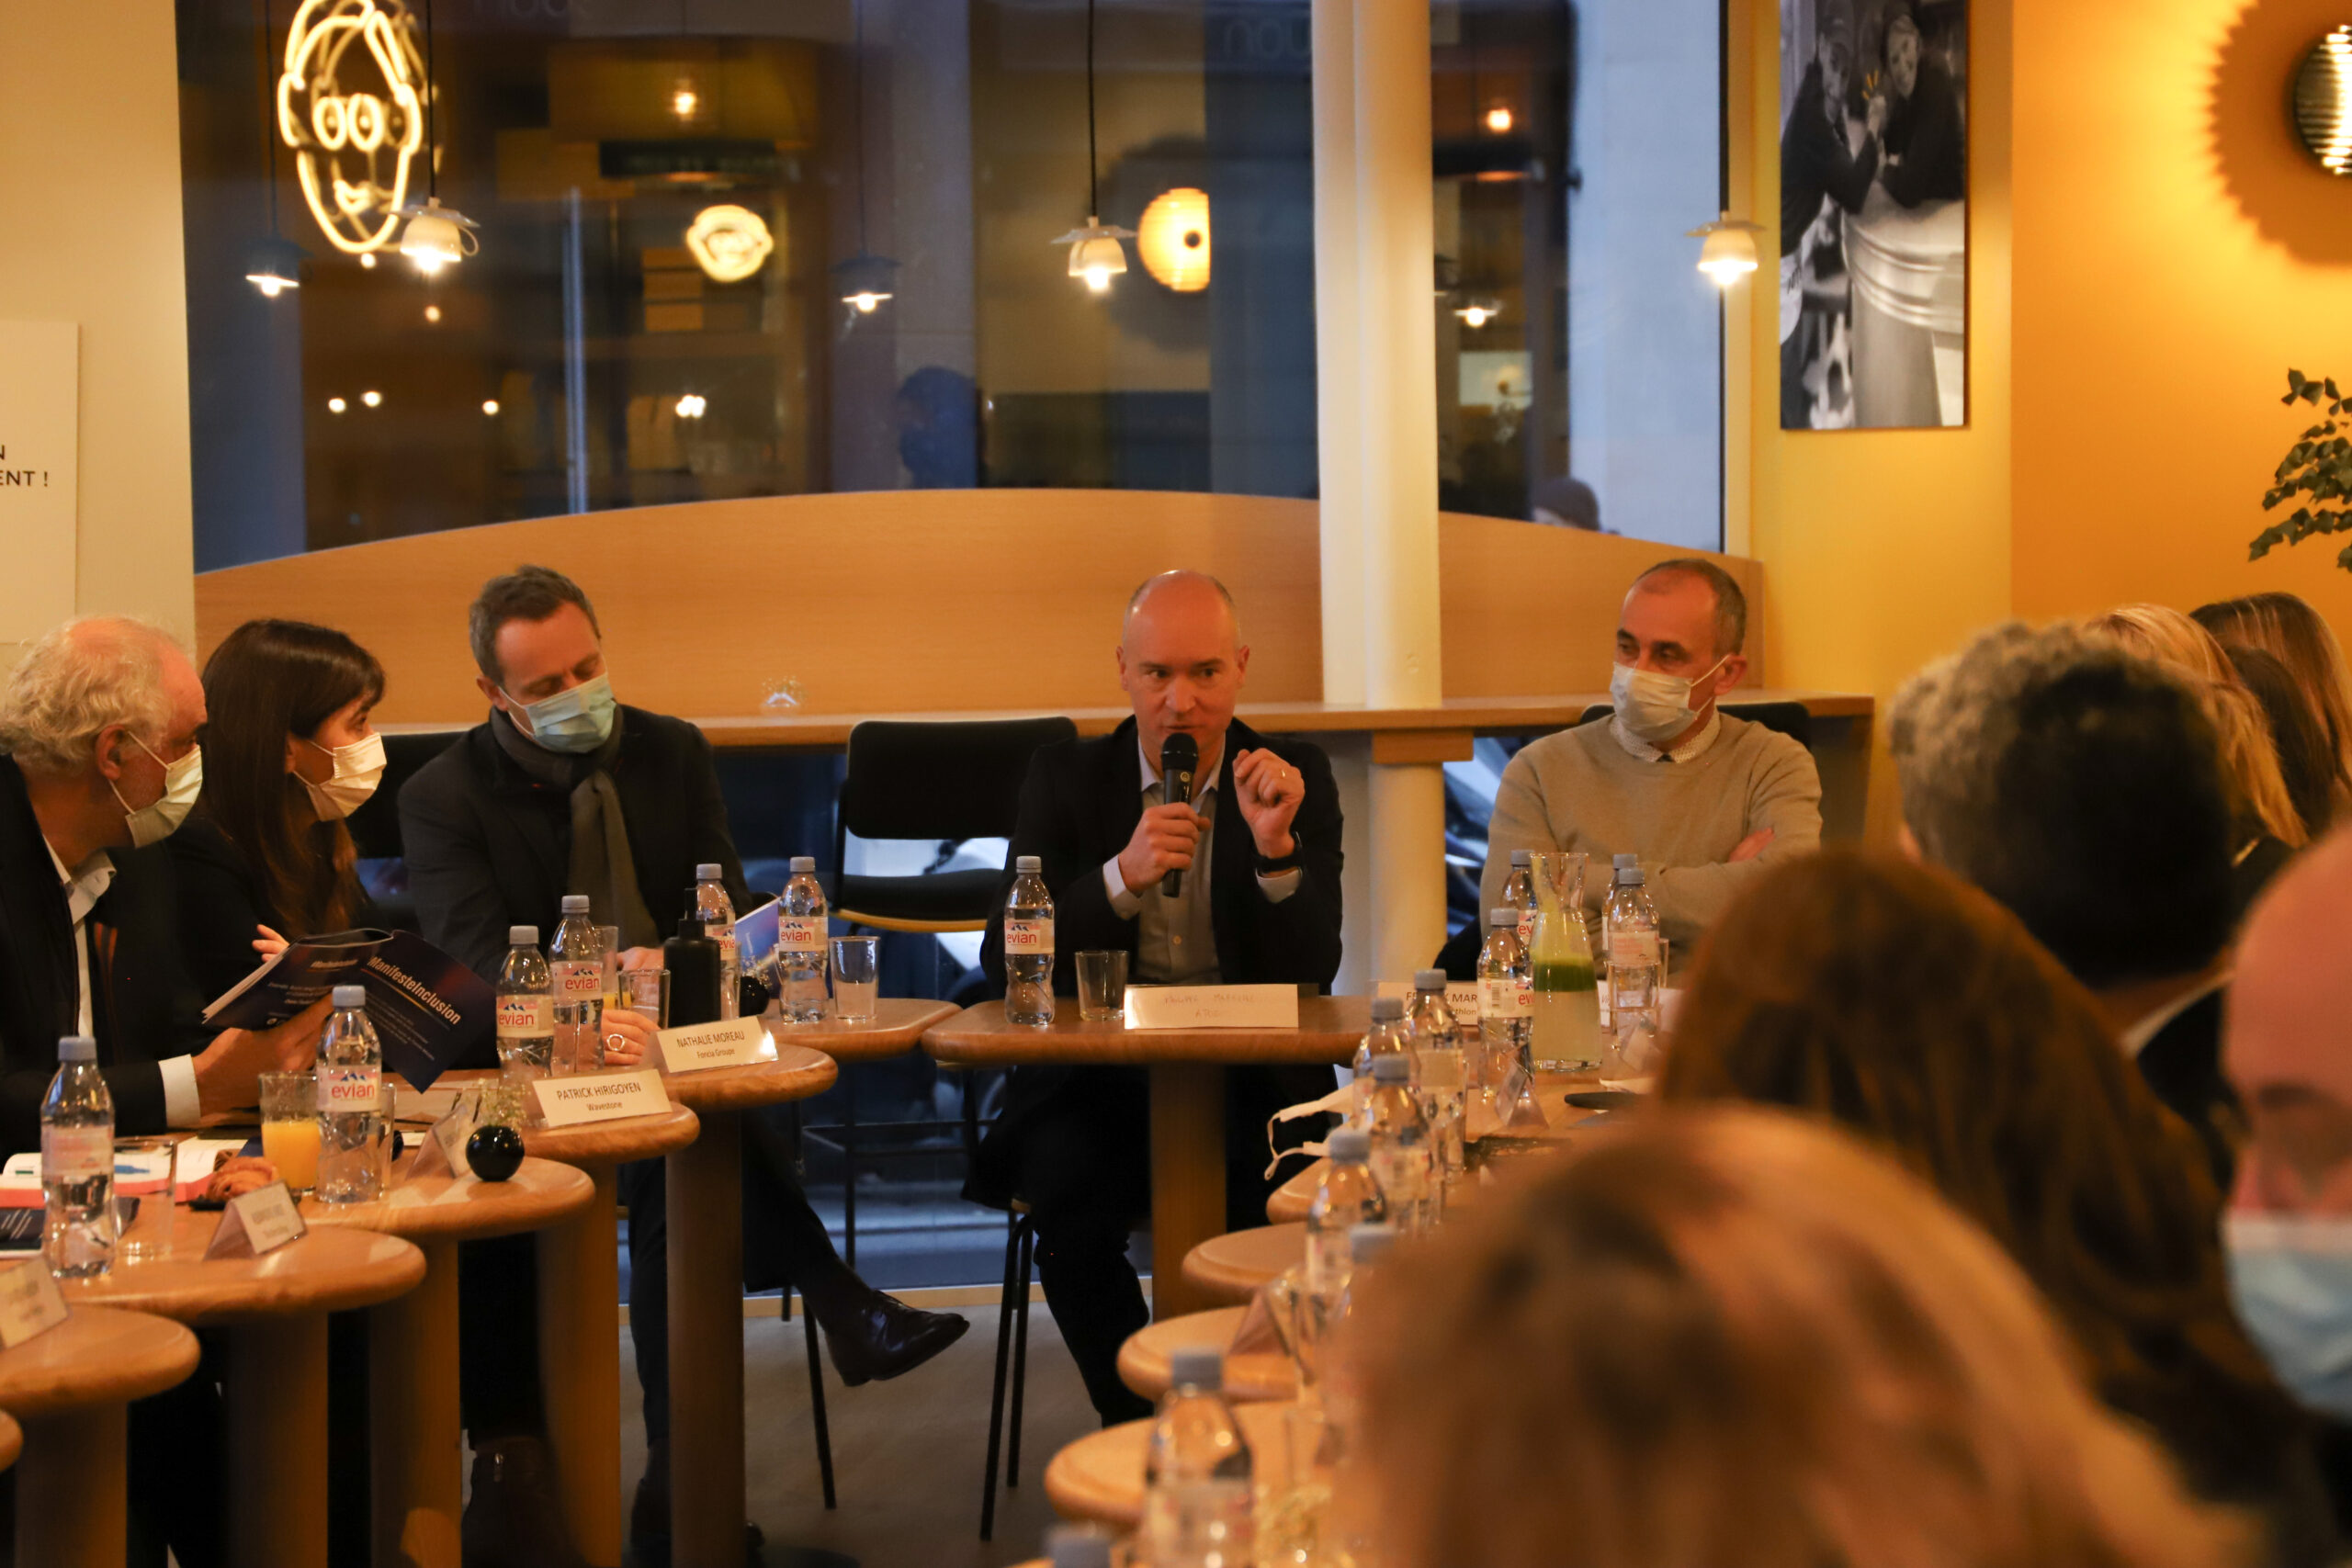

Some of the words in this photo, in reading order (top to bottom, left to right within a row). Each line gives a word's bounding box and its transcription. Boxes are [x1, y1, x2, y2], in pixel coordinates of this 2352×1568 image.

[781, 930, 812, 942] evian
[1006, 931, 1037, 943] evian
[565, 977, 600, 990] evian
[499, 1012, 535, 1026] evian
[676, 1035, 713, 1048] NATHALIE
[713, 1030, 745, 1044] MOREAU
[717, 1047, 736, 1057] Groupe
[332, 1083, 376, 1099] evian
[556, 1088, 594, 1100] PATRICK
[594, 1082, 641, 1097] HIRIGOYEN
